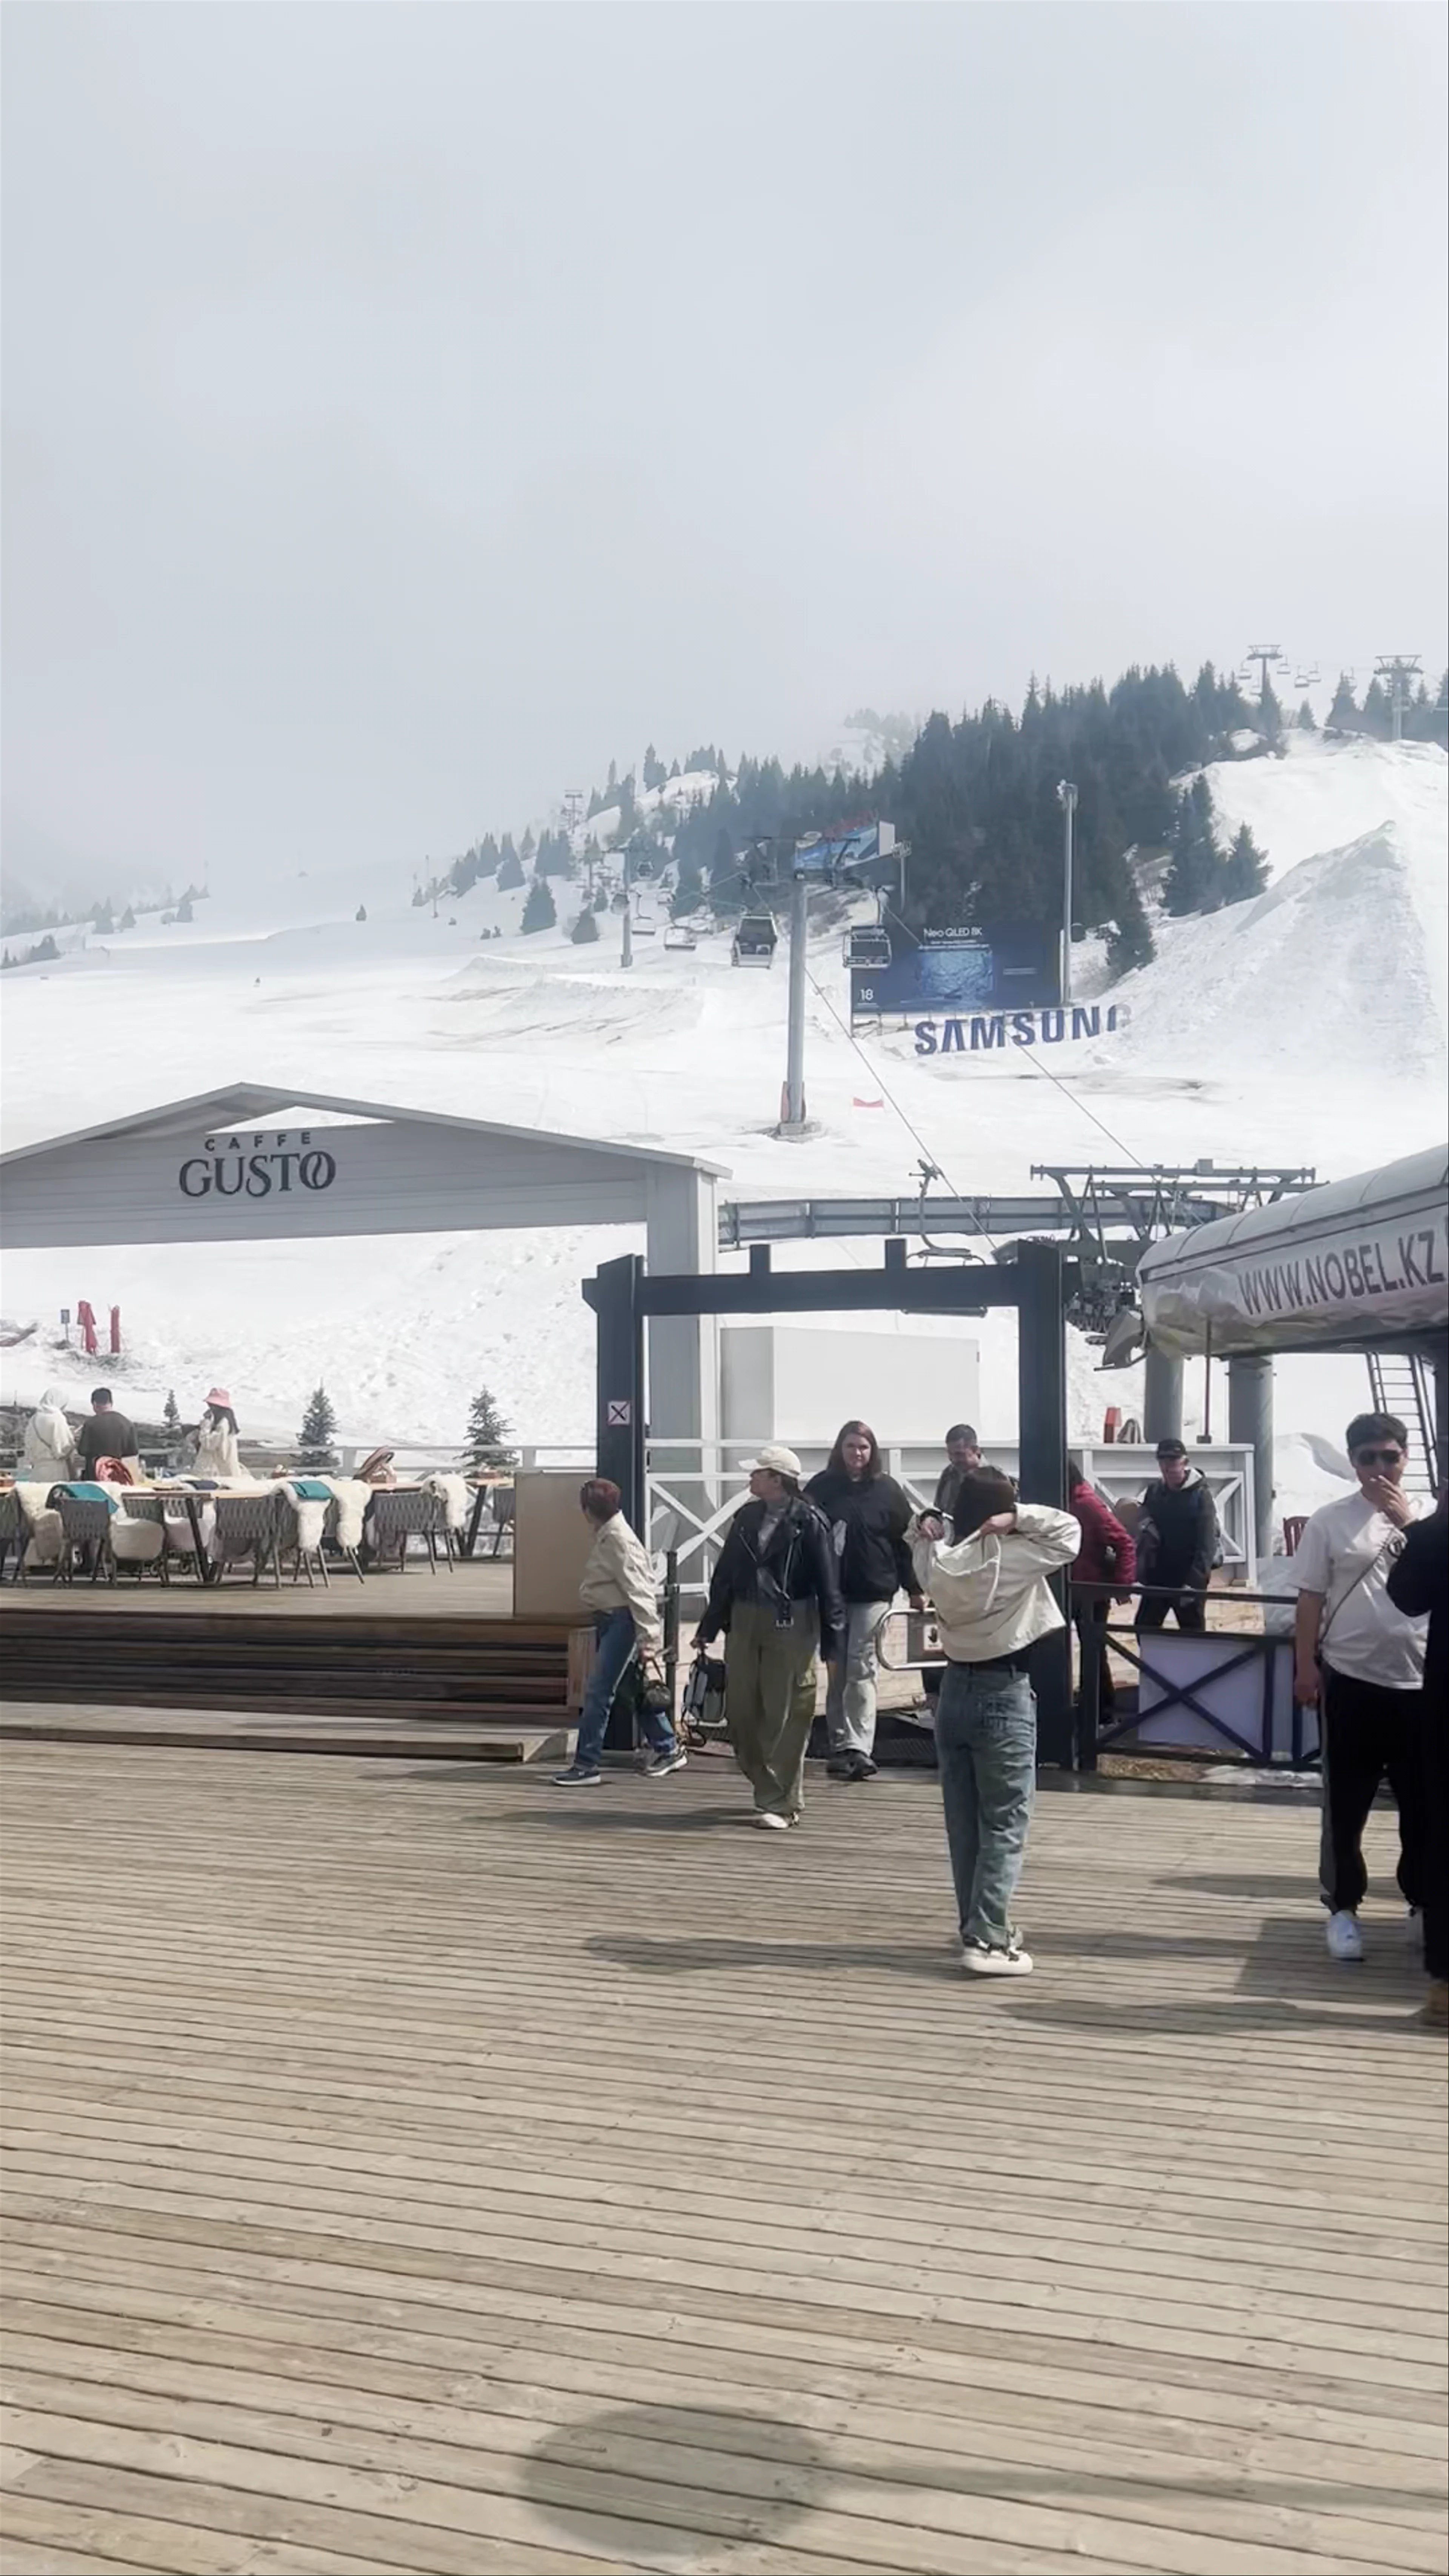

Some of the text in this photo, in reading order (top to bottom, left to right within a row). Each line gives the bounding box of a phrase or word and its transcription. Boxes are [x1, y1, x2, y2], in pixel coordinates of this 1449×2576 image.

[924, 927, 943, 937] Neo
[945, 927, 970, 937] QLED
[861, 988, 874, 1001] 18
[205, 1132, 311, 1151] CAFFE
[179, 1150, 336, 1197] GUSTO
[1238, 1229, 1446, 1315] WWW.NOBEL.KZ
